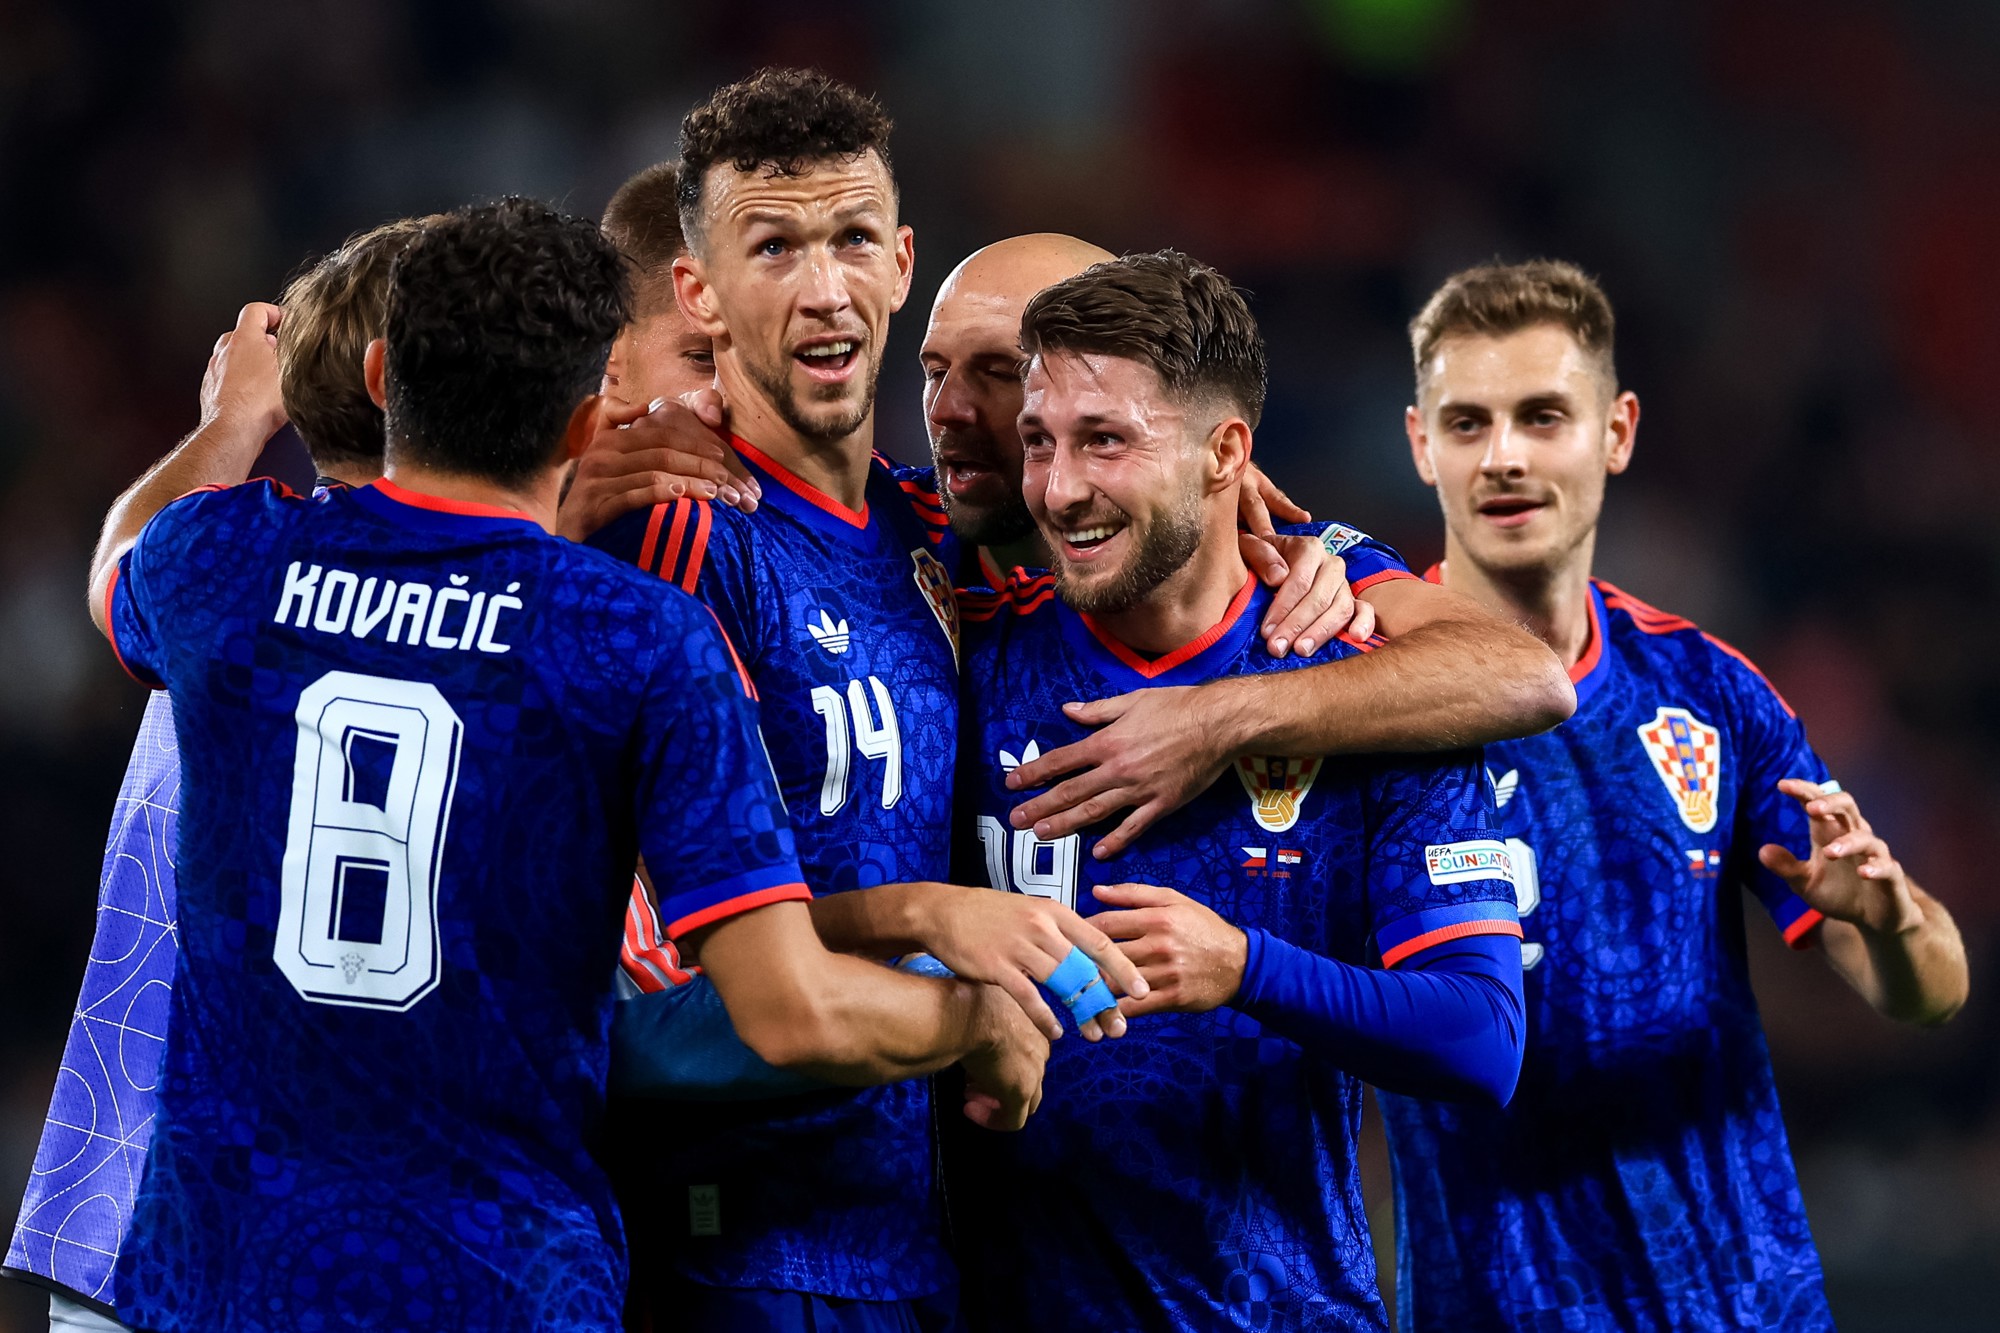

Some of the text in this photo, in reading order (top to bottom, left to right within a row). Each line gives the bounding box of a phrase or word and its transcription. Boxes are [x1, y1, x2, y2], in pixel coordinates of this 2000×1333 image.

[274, 561, 523, 653] KOVAČIĆ
[810, 675, 901, 816] 14
[273, 670, 464, 1012] 8
[977, 815, 1080, 912] 19
[1428, 848, 1452, 857] UEFA
